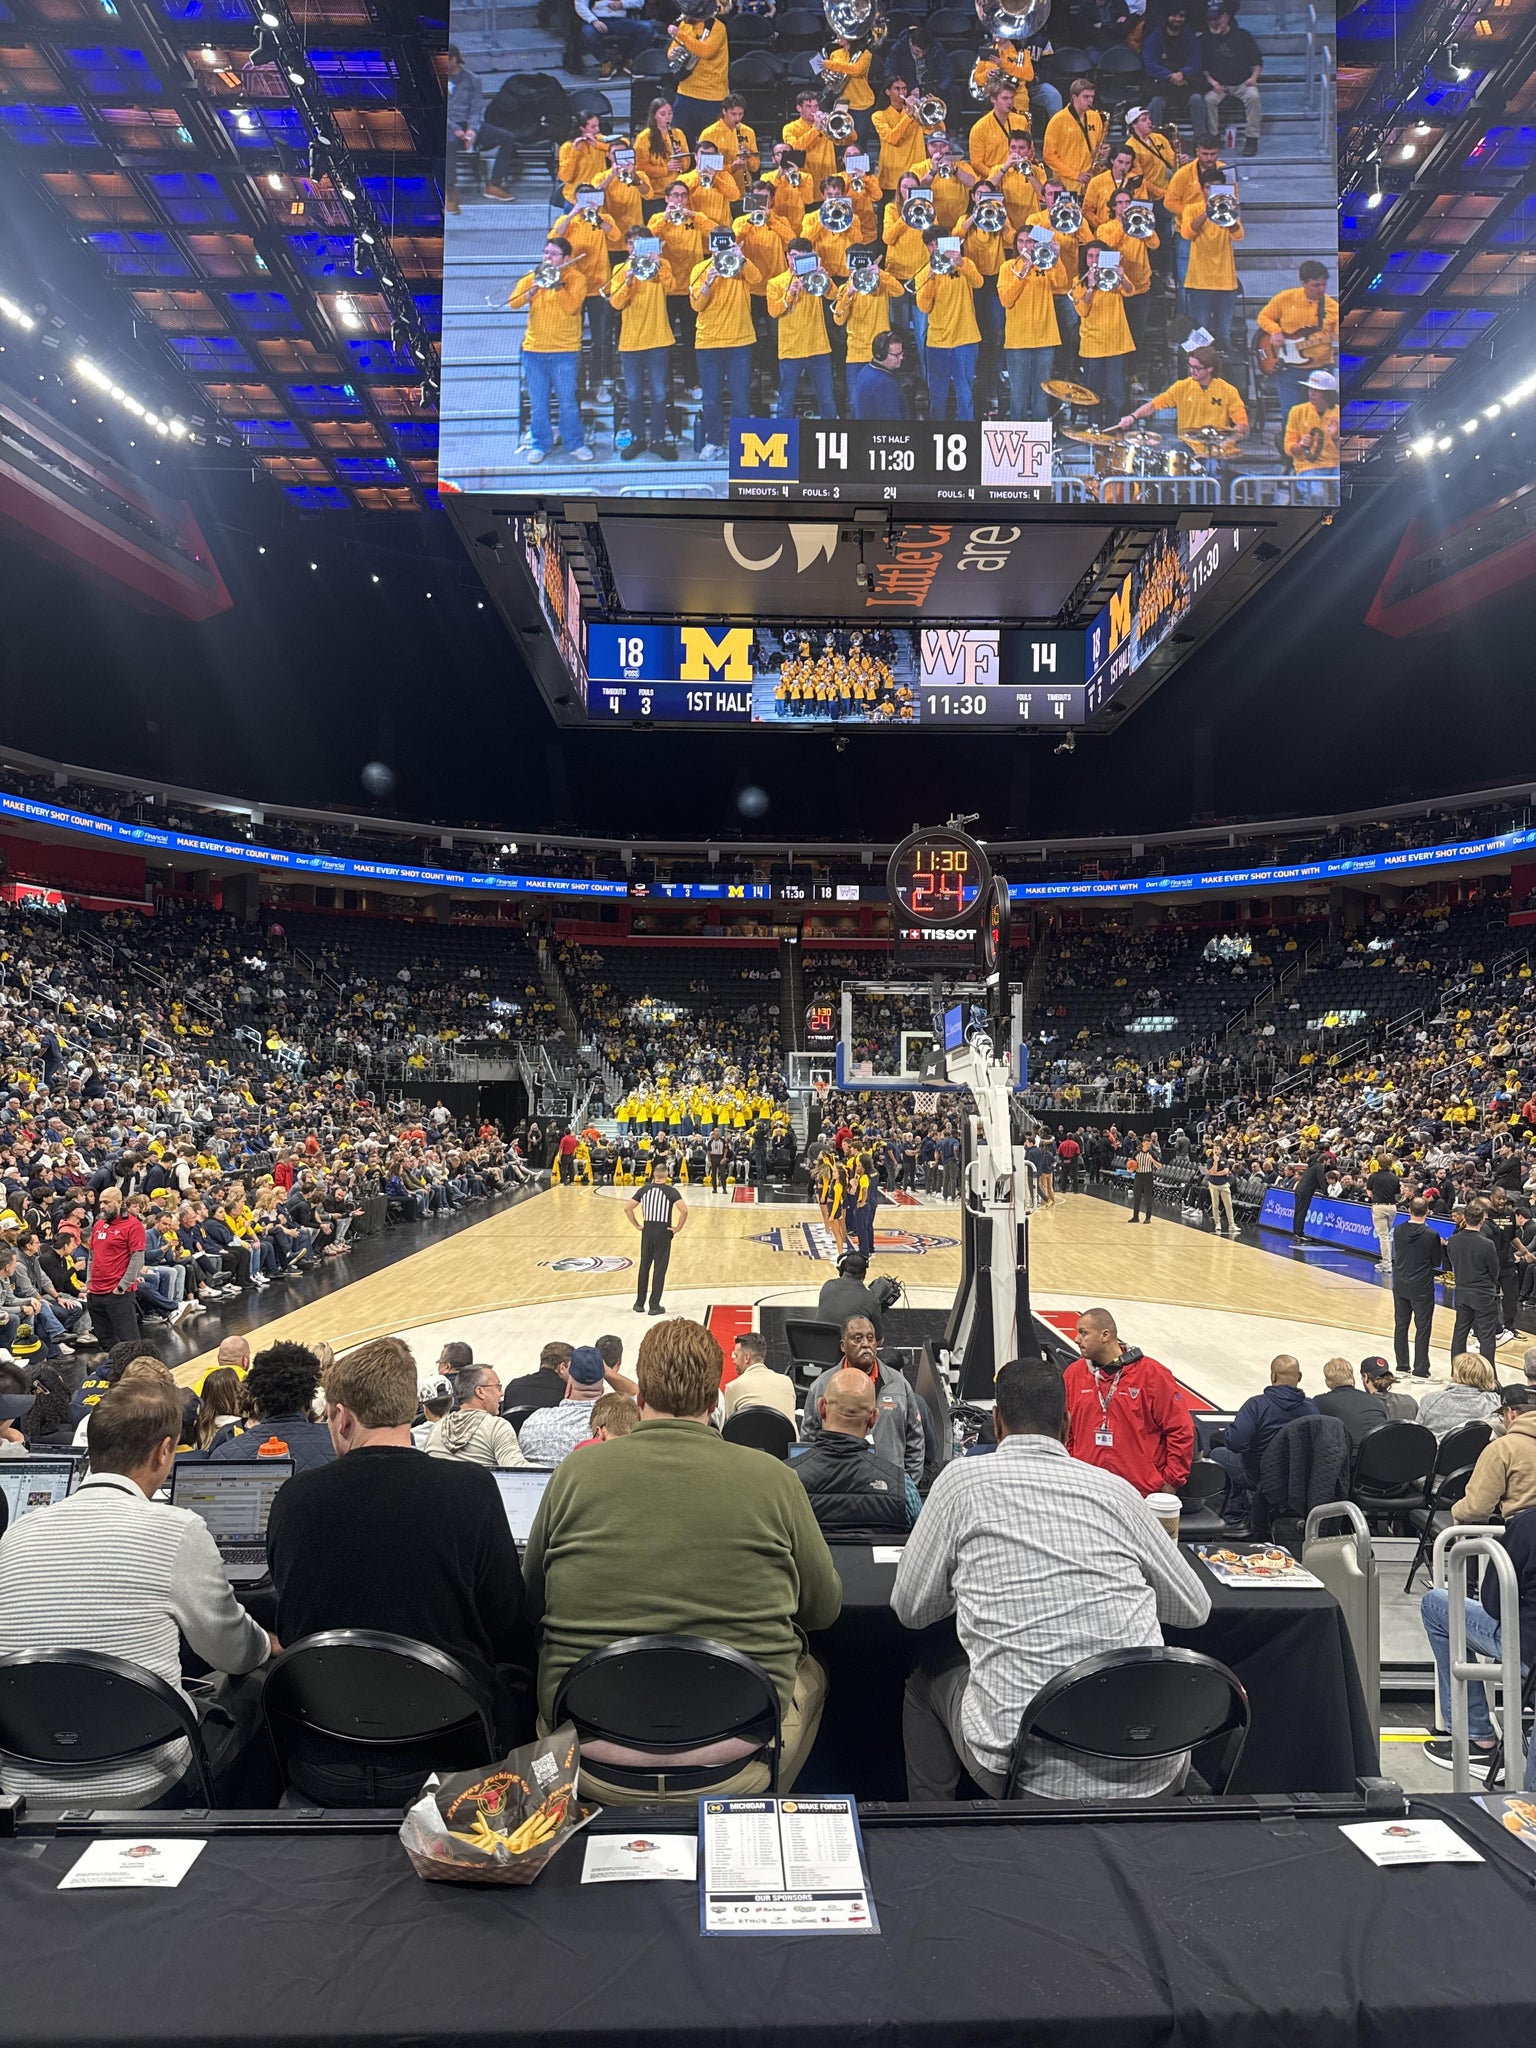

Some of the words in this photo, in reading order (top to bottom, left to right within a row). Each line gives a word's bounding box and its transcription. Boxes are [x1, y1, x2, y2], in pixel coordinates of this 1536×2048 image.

[685, 222, 695, 230] M
[1035, 269, 1046, 277] M
[1211, 397, 1223, 406] M
[872, 435, 887, 444] 1ST
[888, 435, 910, 444] HALF
[740, 432, 788, 468] M
[816, 432, 848, 470] 14
[933, 434, 968, 471] 18
[984, 430, 1050, 477] WF
[869, 450, 915, 471] 11:30
[738, 488, 780, 496] TIMEOUTS:
[782, 486, 789, 498] 4
[802, 488, 830, 497] FOULS:
[833, 487, 840, 498] 3
[884, 487, 897, 499] 24
[938, 490, 965, 498] FOULS:
[968, 488, 975, 500] 4
[989, 490, 1031, 499] TIMEOUTS:
[1033, 488, 1040, 500] 4
[1192, 543, 1219, 592] 11:30
[1109, 572, 1132, 655] M
[618, 638, 644, 667] 18
[680, 628, 753, 680] M
[920, 629, 1000, 685] WF
[1031, 642, 1056, 672] 14
[610, 697, 619, 714] 4
[641, 697, 651, 715] 3
[686, 692, 712, 712] 1ST
[927, 694, 986, 715] 11:30
[1019, 702, 1028, 720] 4
[1054, 702, 1064, 720] 4
[2, 799, 24, 812] MAKE
[26, 804, 50, 818] EVERY
[50, 808, 70, 822] SHOT
[70, 814, 94, 828] COUNT
[94, 820, 112, 832] WITH
[144, 832, 168, 842] Financial
[176, 837, 199, 848] MAKE
[200, 840, 224, 852] EVERY
[224, 845, 244, 856] SHOT
[245, 848, 268, 860] COUNT
[270, 851, 288, 862] WITH
[1384, 854, 1408, 864] MAKE
[1408, 851, 1434, 862] EVERY
[1435, 848, 1458, 858] SHOT
[1459, 844, 1485, 855] COUNT
[1486, 840, 1506, 851] WITH
[916, 850, 968, 871] 11:30
[354, 864, 375, 872] MAKE
[376, 866, 400, 876] EVERY
[400, 869, 420, 878] SHOT
[420, 872, 444, 880] COUNT
[446, 874, 464, 882] WITH
[1201, 875, 1224, 884] MAKE
[1224, 874, 1250, 882] EVERY
[1250, 871, 1272, 880] SHOT
[1273, 869, 1300, 878] COUNT
[1300, 866, 1320, 876] WITH
[526, 880, 546, 888] MAKE
[546, 881, 570, 889] EVERY
[590, 884, 614, 892] COUNT
[728, 886, 744, 898] M
[753, 886, 763, 898] 14
[780, 890, 804, 898] 11:30
[821, 886, 832, 898] 18
[912, 874, 962, 912] 24
[1048, 886, 1071, 894] EVERY
[1092, 884, 1118, 892] COUNT
[921, 930, 977, 940] TISSOT
[812, 1008, 832, 1016] 11:30
[812, 1016, 830, 1030] 24
[1335, 1216, 1372, 1236] Skyscanner
[82, 1380, 96, 1388] GO
[446, 1783, 482, 1820] Fairway
[483, 1772, 520, 1787] Packing
[730, 1802, 766, 1810] MICHIGAN
[798, 1802, 819, 1810] WAKE
[755, 1894, 770, 1902] OUR
